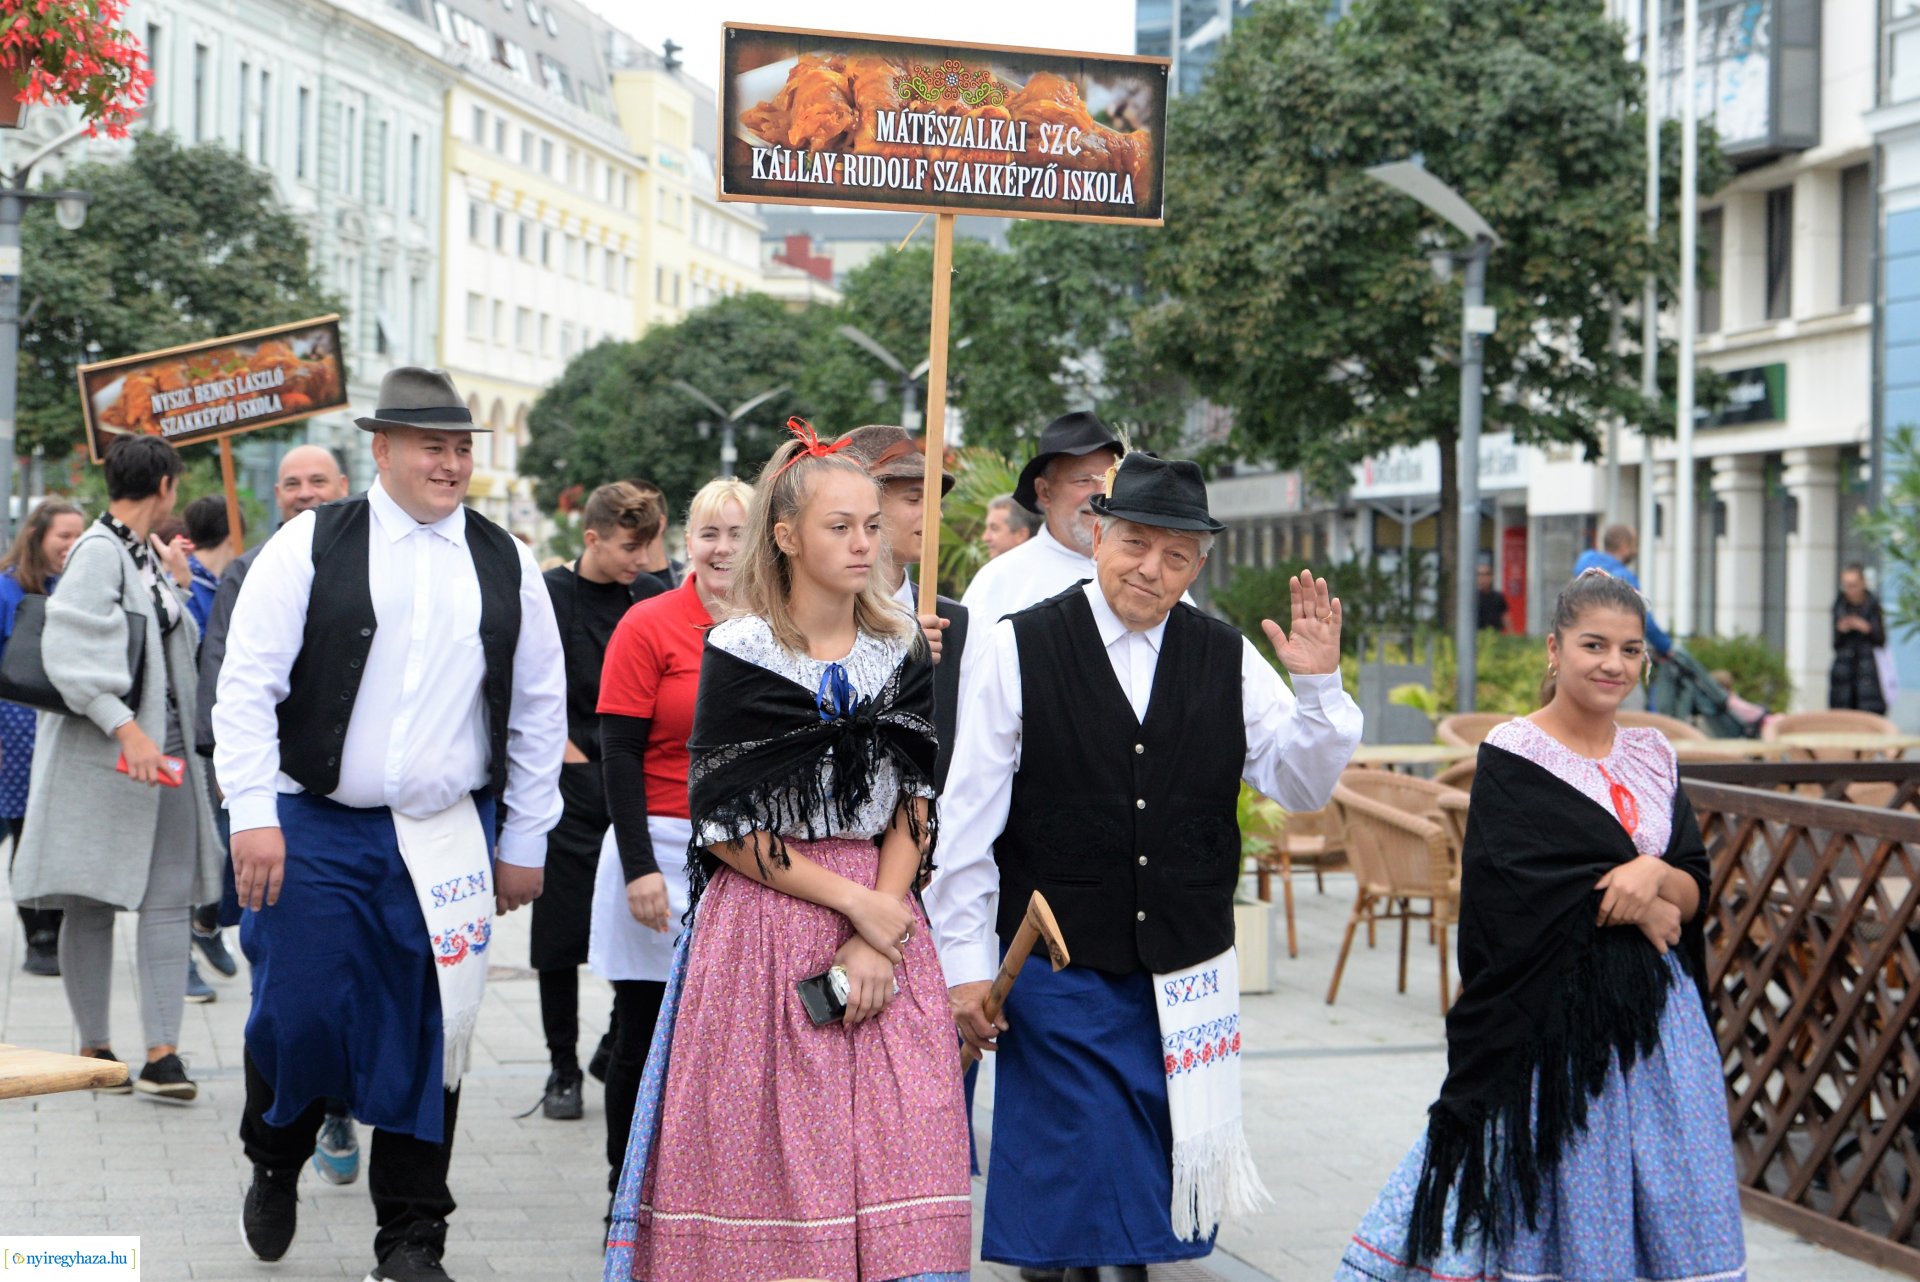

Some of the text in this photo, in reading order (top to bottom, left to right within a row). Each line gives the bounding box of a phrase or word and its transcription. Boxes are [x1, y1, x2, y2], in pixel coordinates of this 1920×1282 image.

[876, 109, 1082, 157] MÁTÉSZALKAI SZC
[751, 144, 1135, 205] KÁLLAY RUDOLF SZAKKÉPZŐ ISKOLA
[194, 380, 236, 404] BENCS
[237, 394, 283, 420] ISKOLA
[431, 870, 487, 908] SZM
[1164, 969, 1219, 1007] SZM
